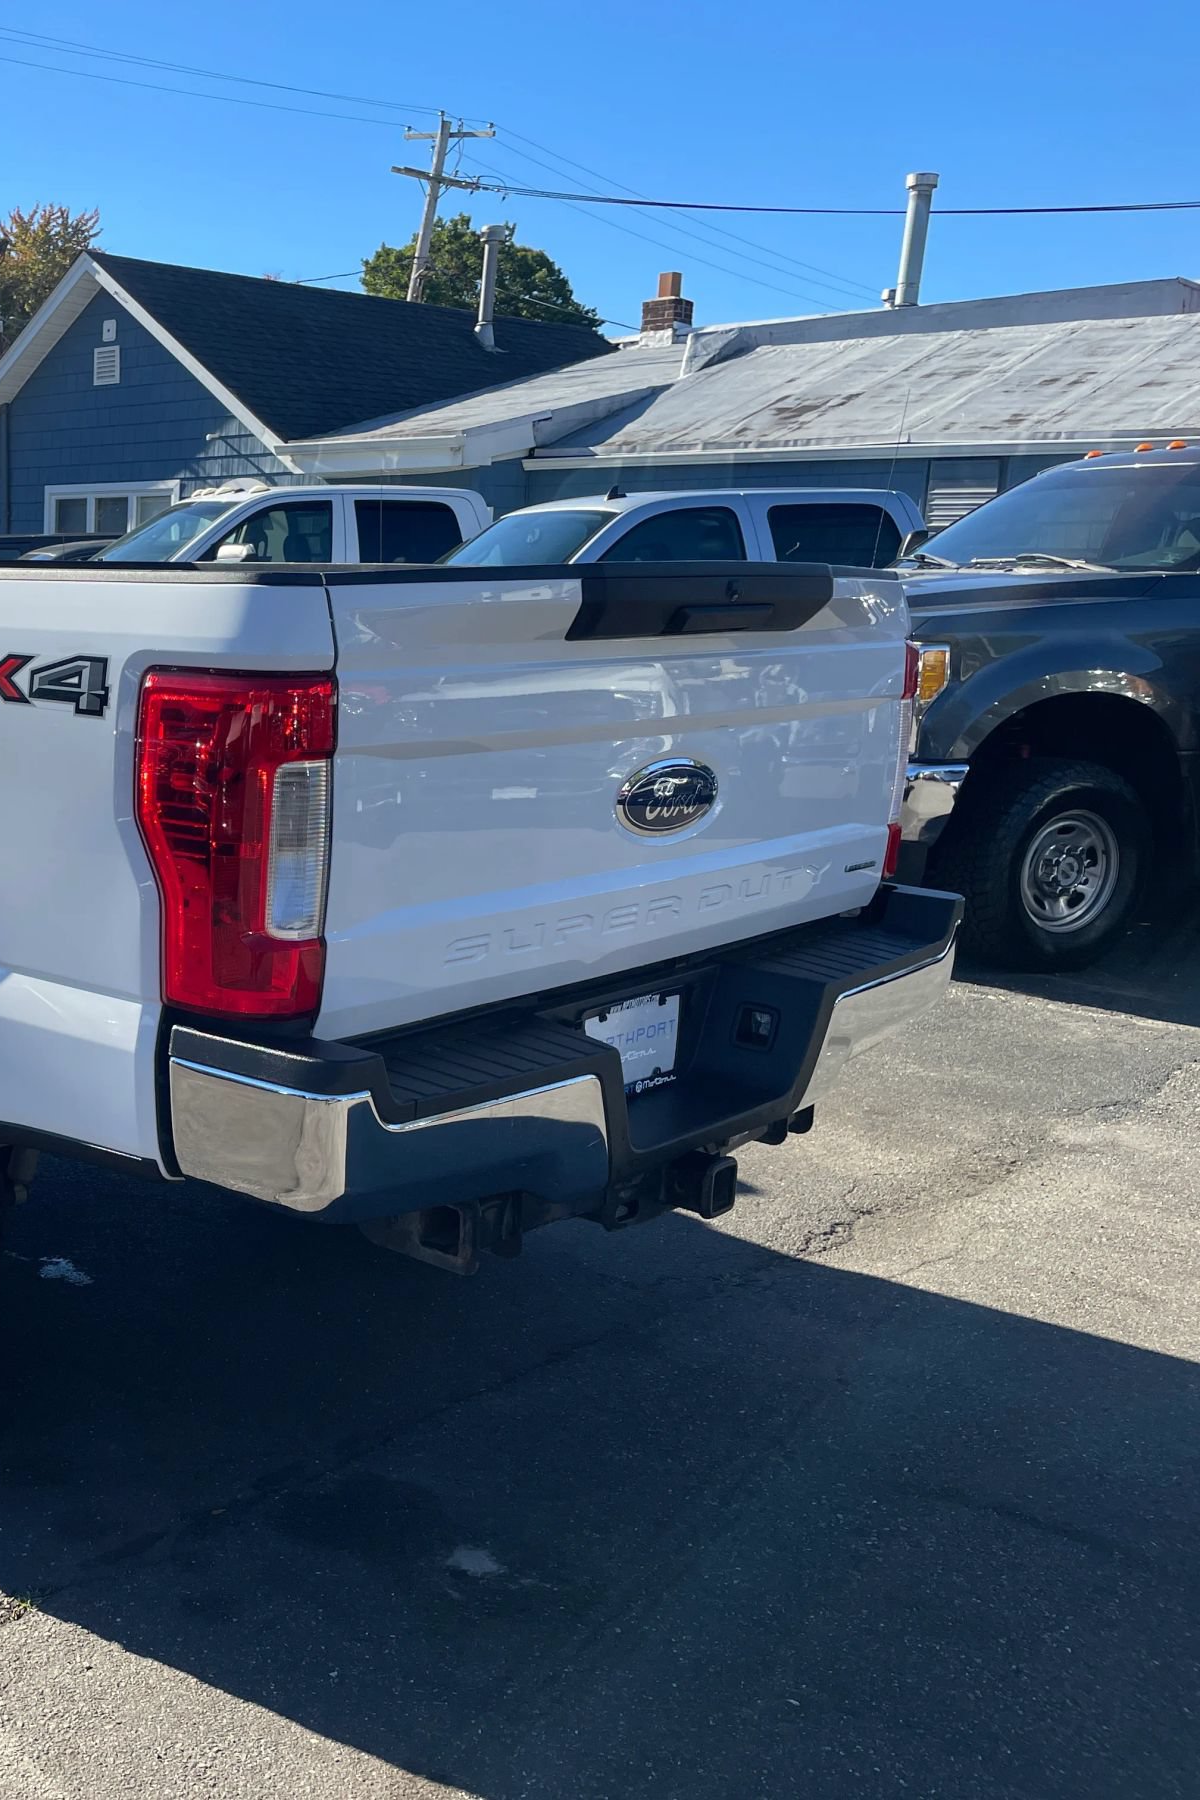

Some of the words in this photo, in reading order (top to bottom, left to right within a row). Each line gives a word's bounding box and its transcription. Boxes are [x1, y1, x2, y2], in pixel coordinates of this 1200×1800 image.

[443, 895, 682, 967] SUPER
[698, 861, 832, 911] DUTY
[605, 1019, 676, 1047] RTHPORT
